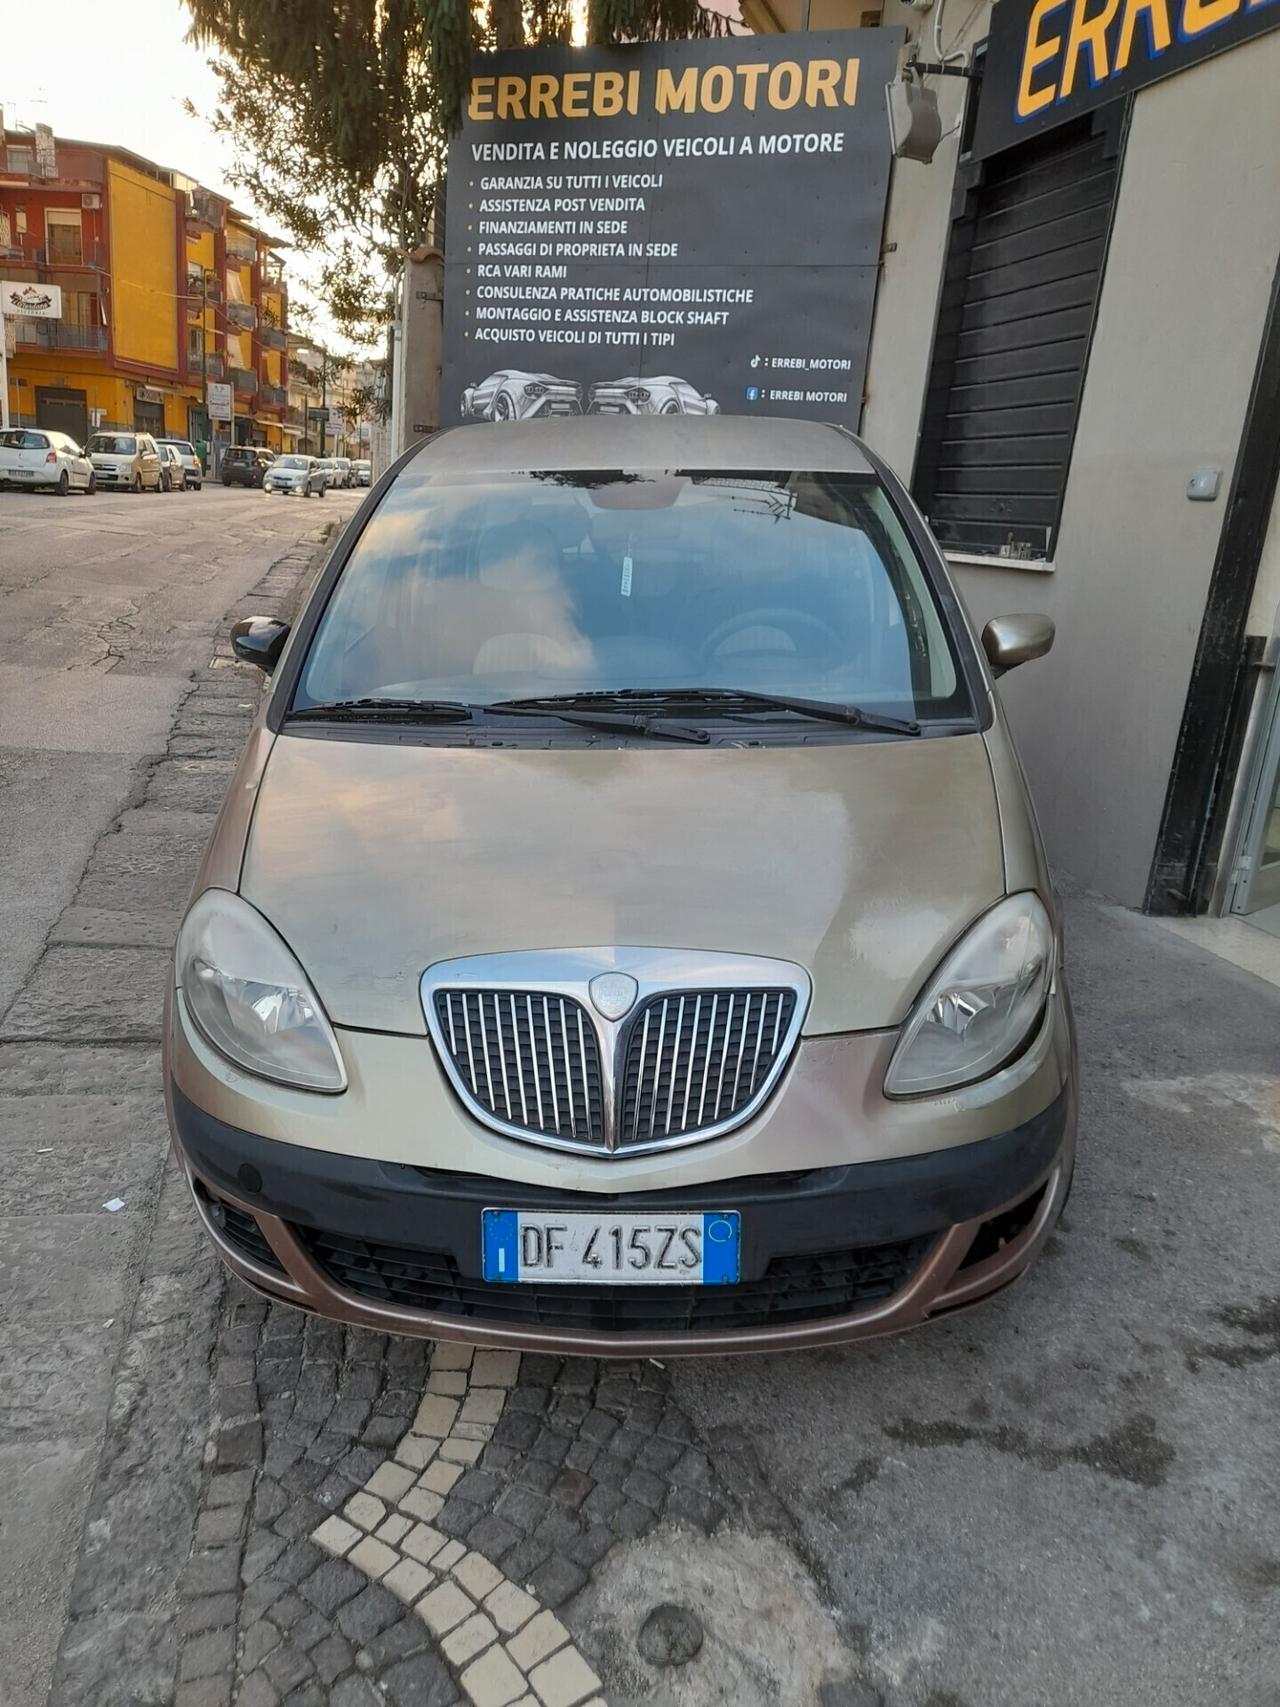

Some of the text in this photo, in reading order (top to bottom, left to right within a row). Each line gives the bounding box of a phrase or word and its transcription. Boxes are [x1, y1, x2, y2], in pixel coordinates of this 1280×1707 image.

[467, 57, 861, 121] ERREBI MOTORI
[472, 132, 845, 161] VENDITA E NOLEGGIO VEICOLI A MOTORE
[480, 174, 663, 190] GARANZIA SU TUTTI I VEICOLI
[479, 197, 646, 212] ASSISTENZA POST VENDITA
[479, 221, 628, 234] FINANZIAMENTI IN SEDE
[478, 243, 679, 256] PASSAGGI DI PROPRIETA IN SEDE
[477, 265, 567, 278] RCA VARI RAMI
[476, 286, 754, 303] CONSULENZA PRATICHE AUTOMOBILISTICHE
[476, 306, 729, 325] MONTAGGIO E ASSISTENZA BLOCK SHAFT
[475, 328, 675, 346] ACQUISTO VEICOLI DI TUTTI I TIPI
[771, 357, 851, 371] ERREBI_MOTORI
[770, 390, 803, 401] ERREBI
[806, 391, 847, 403] MOTORI
[520, 1223, 702, 1270] DF 415ZS
